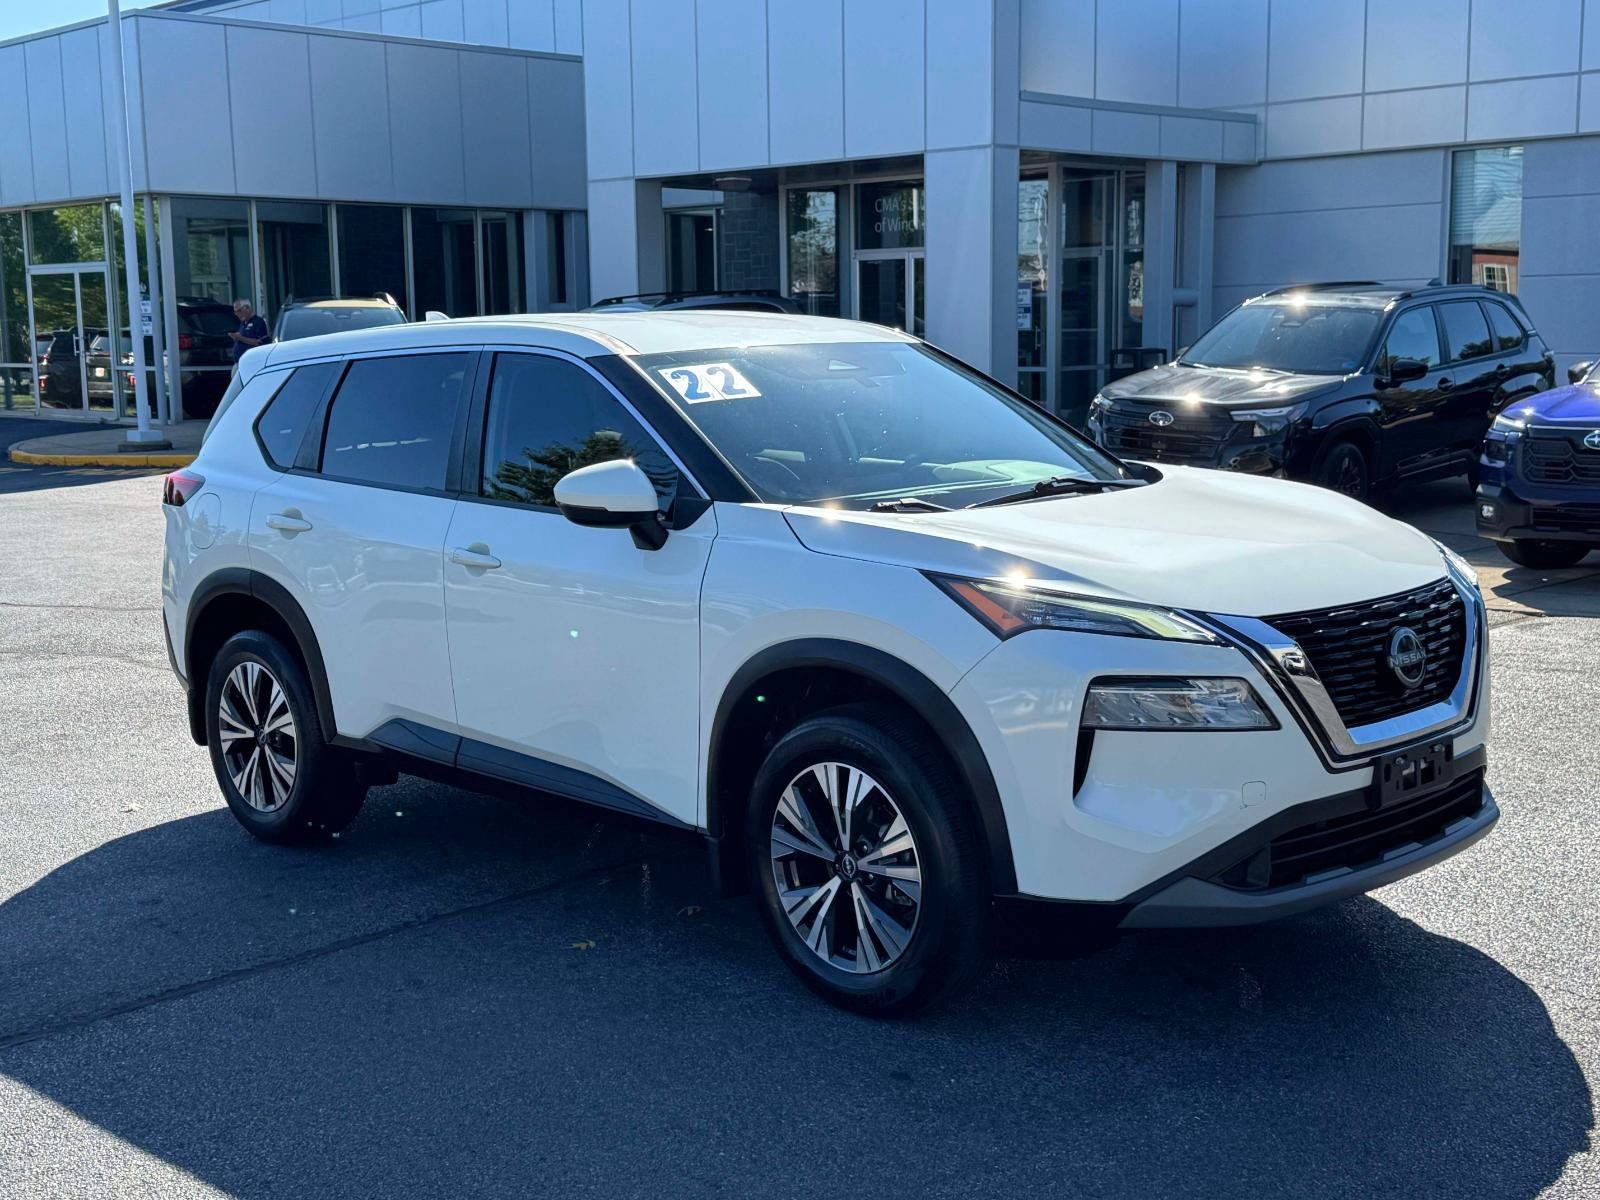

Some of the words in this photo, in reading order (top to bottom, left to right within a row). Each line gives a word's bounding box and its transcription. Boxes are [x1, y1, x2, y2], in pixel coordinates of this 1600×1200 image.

[874, 197, 906, 213] CMA's
[874, 216, 886, 233] of
[886, 217, 924, 233] Winc
[670, 366, 748, 400] 22
[1389, 650, 1425, 669] NISSAN
